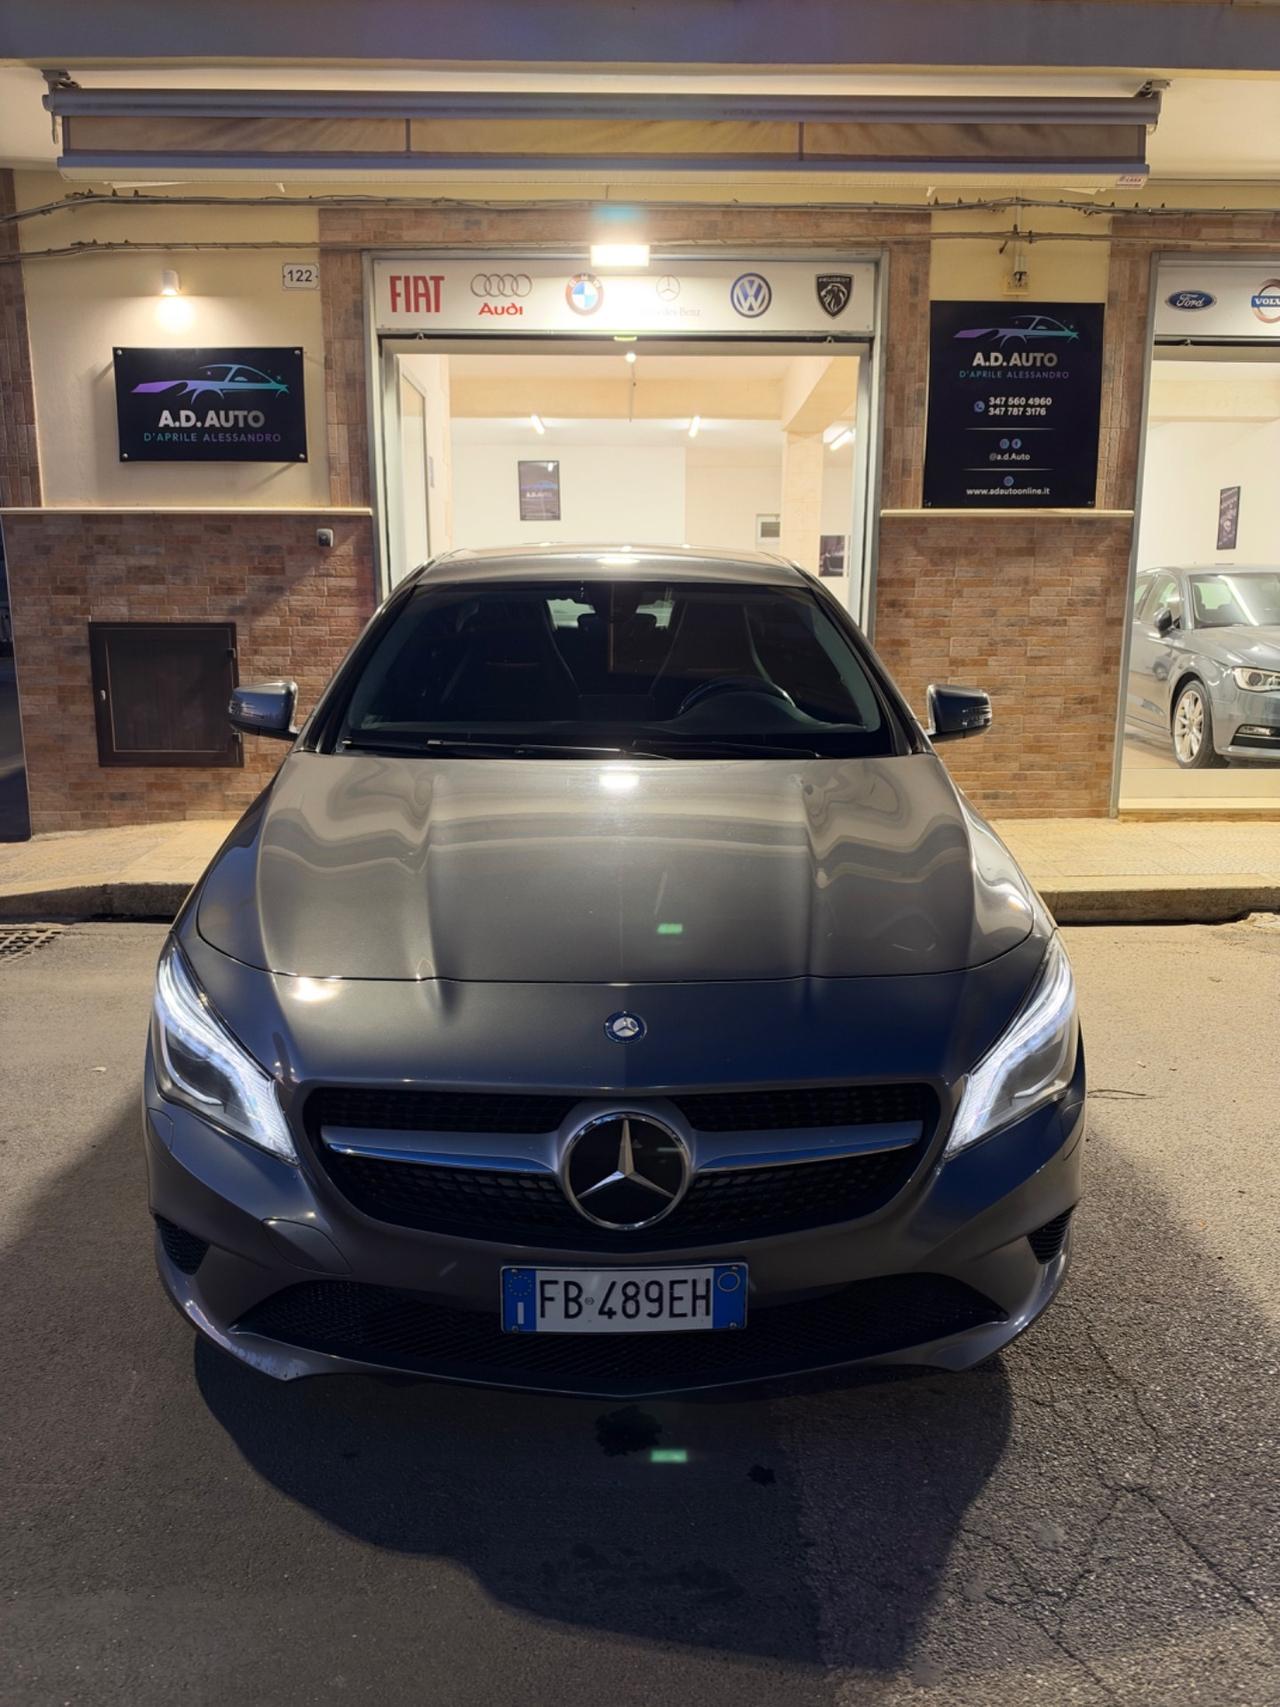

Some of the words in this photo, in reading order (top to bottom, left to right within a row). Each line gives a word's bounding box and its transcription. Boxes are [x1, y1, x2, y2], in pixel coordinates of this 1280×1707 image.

[287, 269, 313, 282] 122
[389, 275, 445, 313] FIAT
[1176, 293, 1206, 308] Ford
[478, 302, 524, 316] Audi
[972, 352, 1007, 367] A.D.
[1008, 352, 1058, 368] AUTO
[959, 370, 1003, 379] D'APRILE
[1006, 370, 1070, 380] ALESSANDRO
[988, 397, 1006, 406] 347
[1007, 397, 1026, 406] 560
[1027, 397, 1053, 406] 4960
[988, 407, 1006, 416] 347
[1007, 407, 1024, 416] 787
[158, 409, 201, 428] A.D.
[203, 409, 266, 429] AUTO
[143, 432, 198, 442] D'APRILE
[202, 432, 282, 443] ALESSANDRO
[966, 486, 1050, 496] www.adautoonline.it
[539, 1279, 584, 1320] FB
[597, 1278, 712, 1320] 489EH
